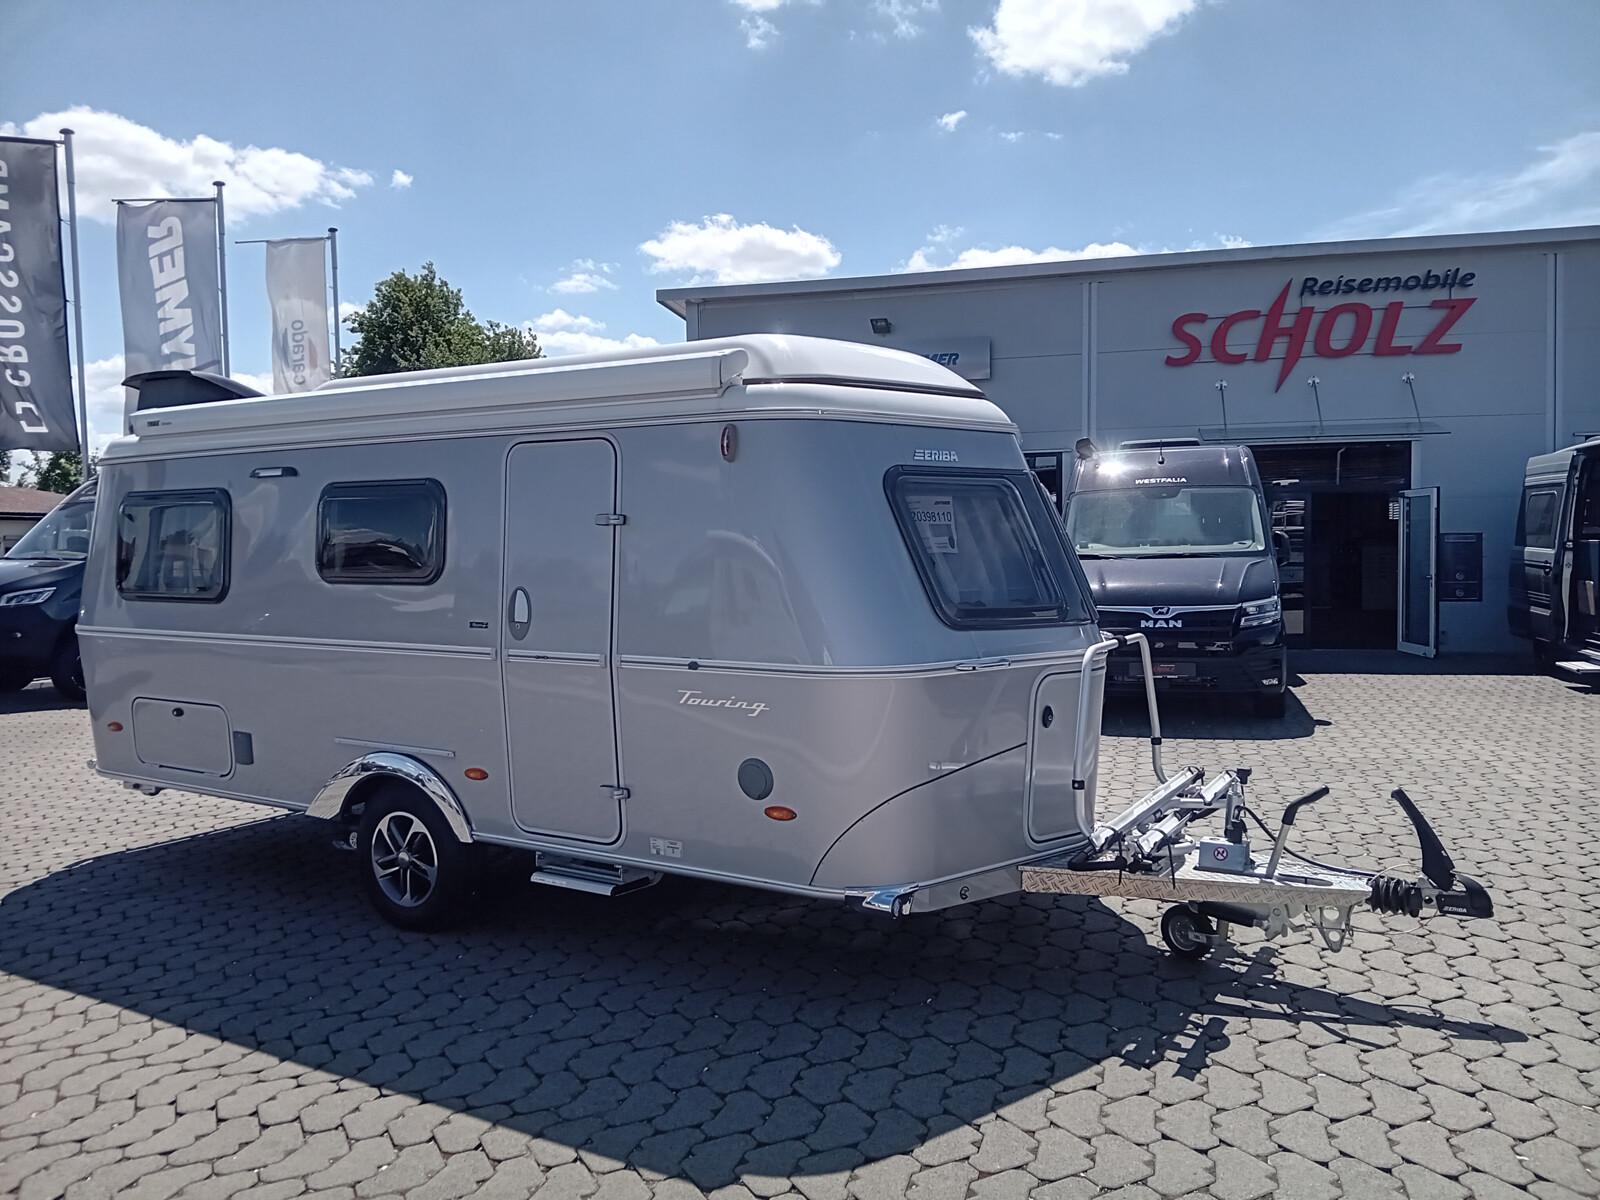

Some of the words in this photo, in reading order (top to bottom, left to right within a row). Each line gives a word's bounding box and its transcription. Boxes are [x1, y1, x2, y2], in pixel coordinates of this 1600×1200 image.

[1300, 268, 1477, 297] Reisemobile
[1165, 278, 1478, 393] SCHOLZ
[924, 449, 959, 462] ERIBA
[1135, 477, 1188, 485] WESTFALIA
[1140, 619, 1182, 628] MAN
[678, 689, 769, 718] Touring
